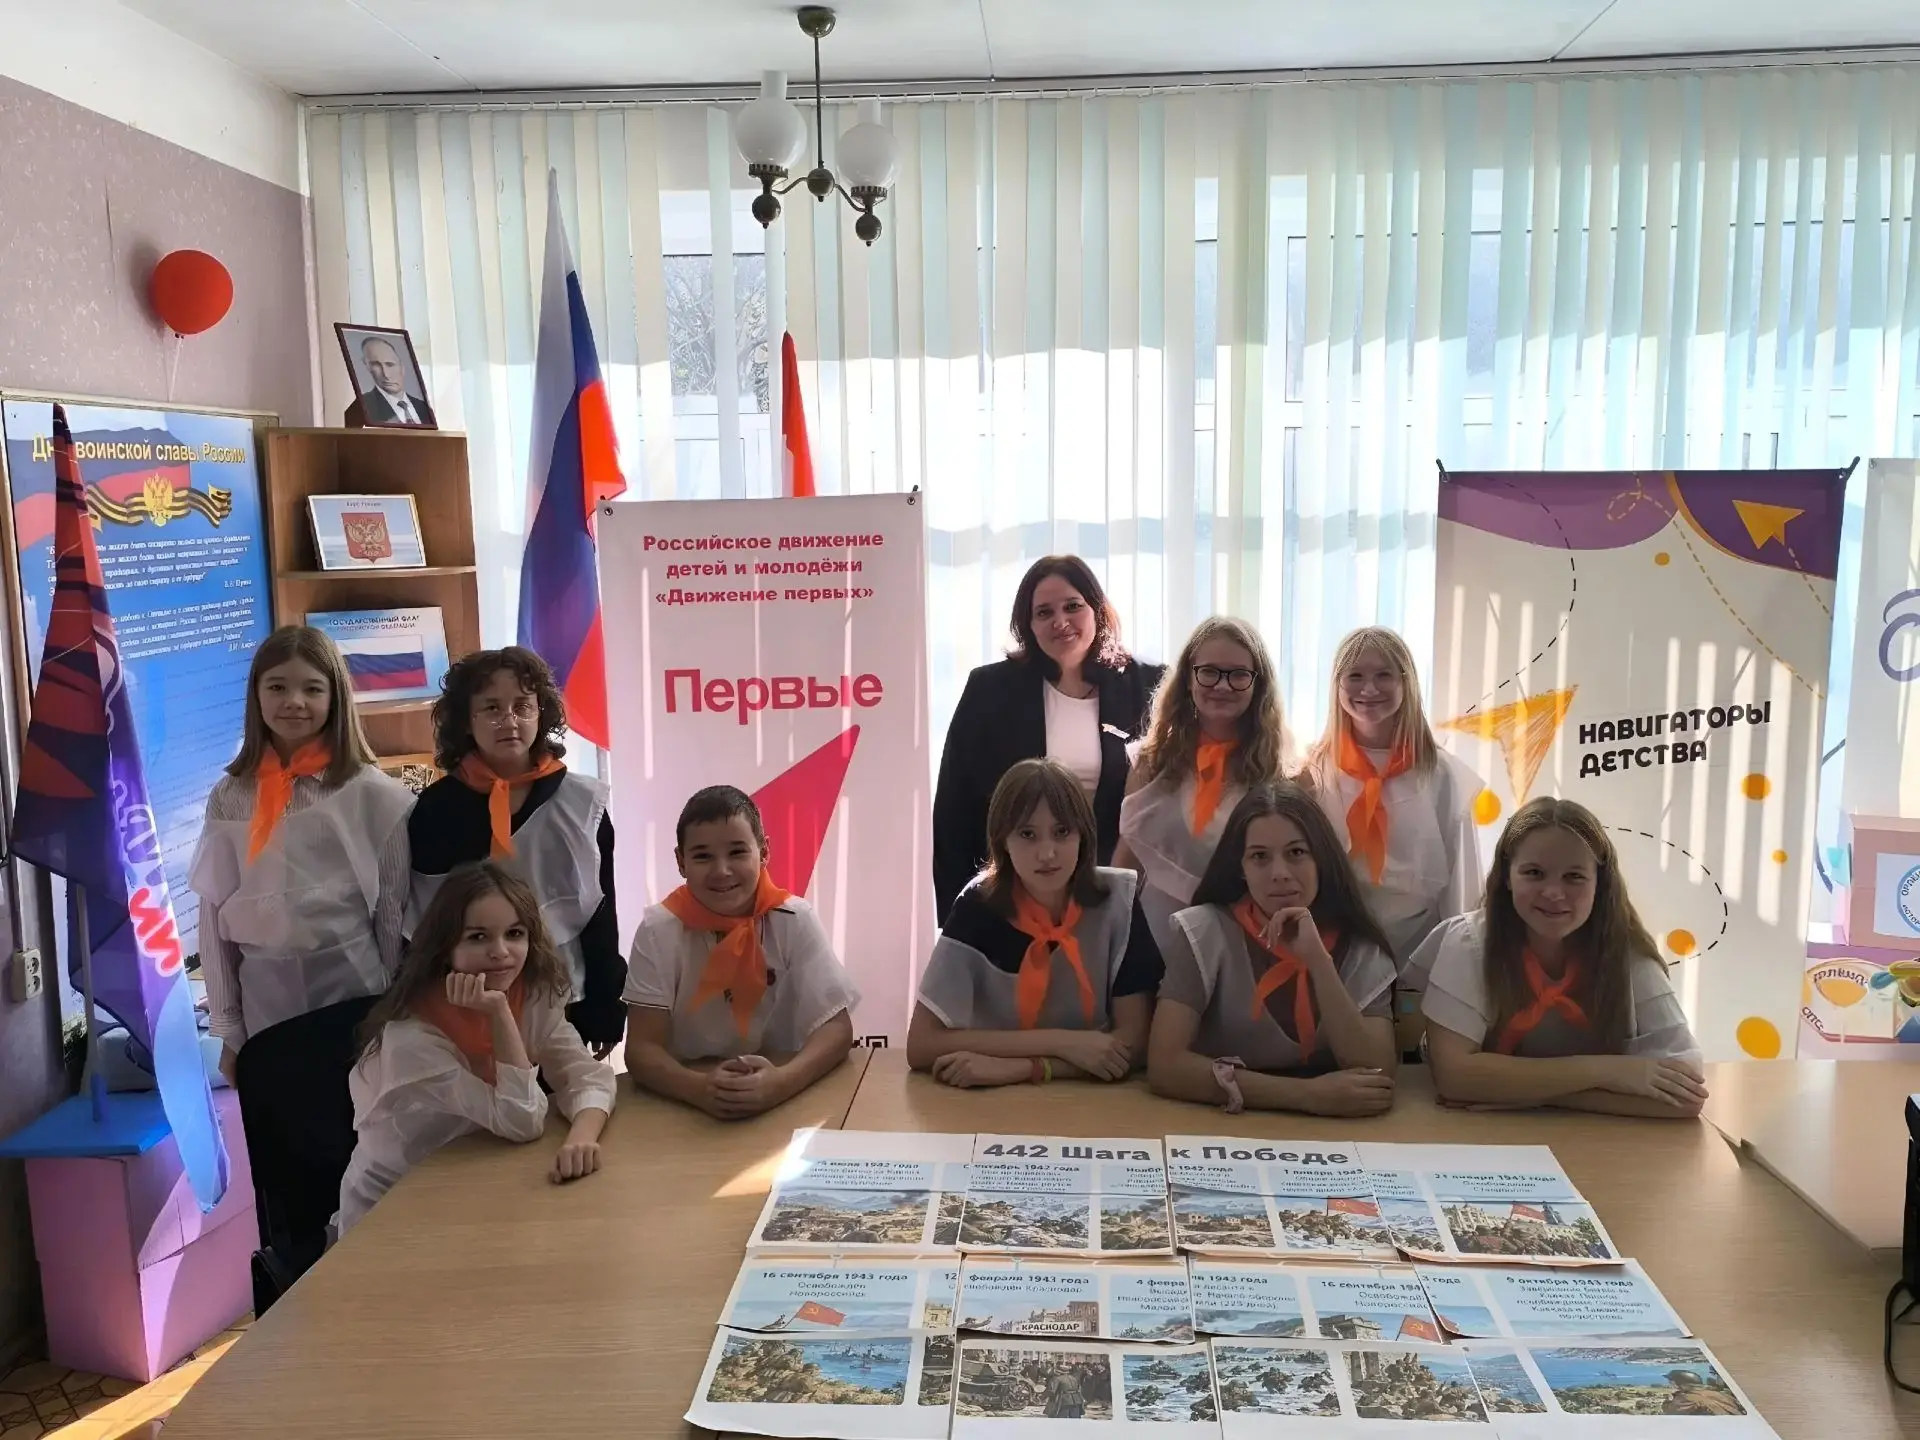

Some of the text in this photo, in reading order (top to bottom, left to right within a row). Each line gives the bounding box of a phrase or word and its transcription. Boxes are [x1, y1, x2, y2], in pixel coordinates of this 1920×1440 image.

[33, 432, 246, 463] Дн воинской славы России
[643, 533, 884, 551] Российское движение
[666, 558, 862, 579] детей и молодёжи
[656, 586, 874, 605] «Движение первых»
[664, 669, 884, 725] Первые
[1579, 701, 1771, 744] НАВИГАТОРЫ
[1580, 740, 1707, 778] ДЕТСТВА
[983, 1144, 1349, 1165] 442 Шага к Победе
[780, 1272, 839, 1280] сентября
[945, 1272, 957, 1280] 12
[969, 1274, 1023, 1282] февраля
[1029, 1275, 1056, 1283] 1943
[1210, 1275, 1237, 1283] 1943
[1518, 1278, 1569, 1286] октября
[1339, 1282, 1396, 1291] сентября
[1021, 1323, 1080, 1331] КРАСНОДАР
